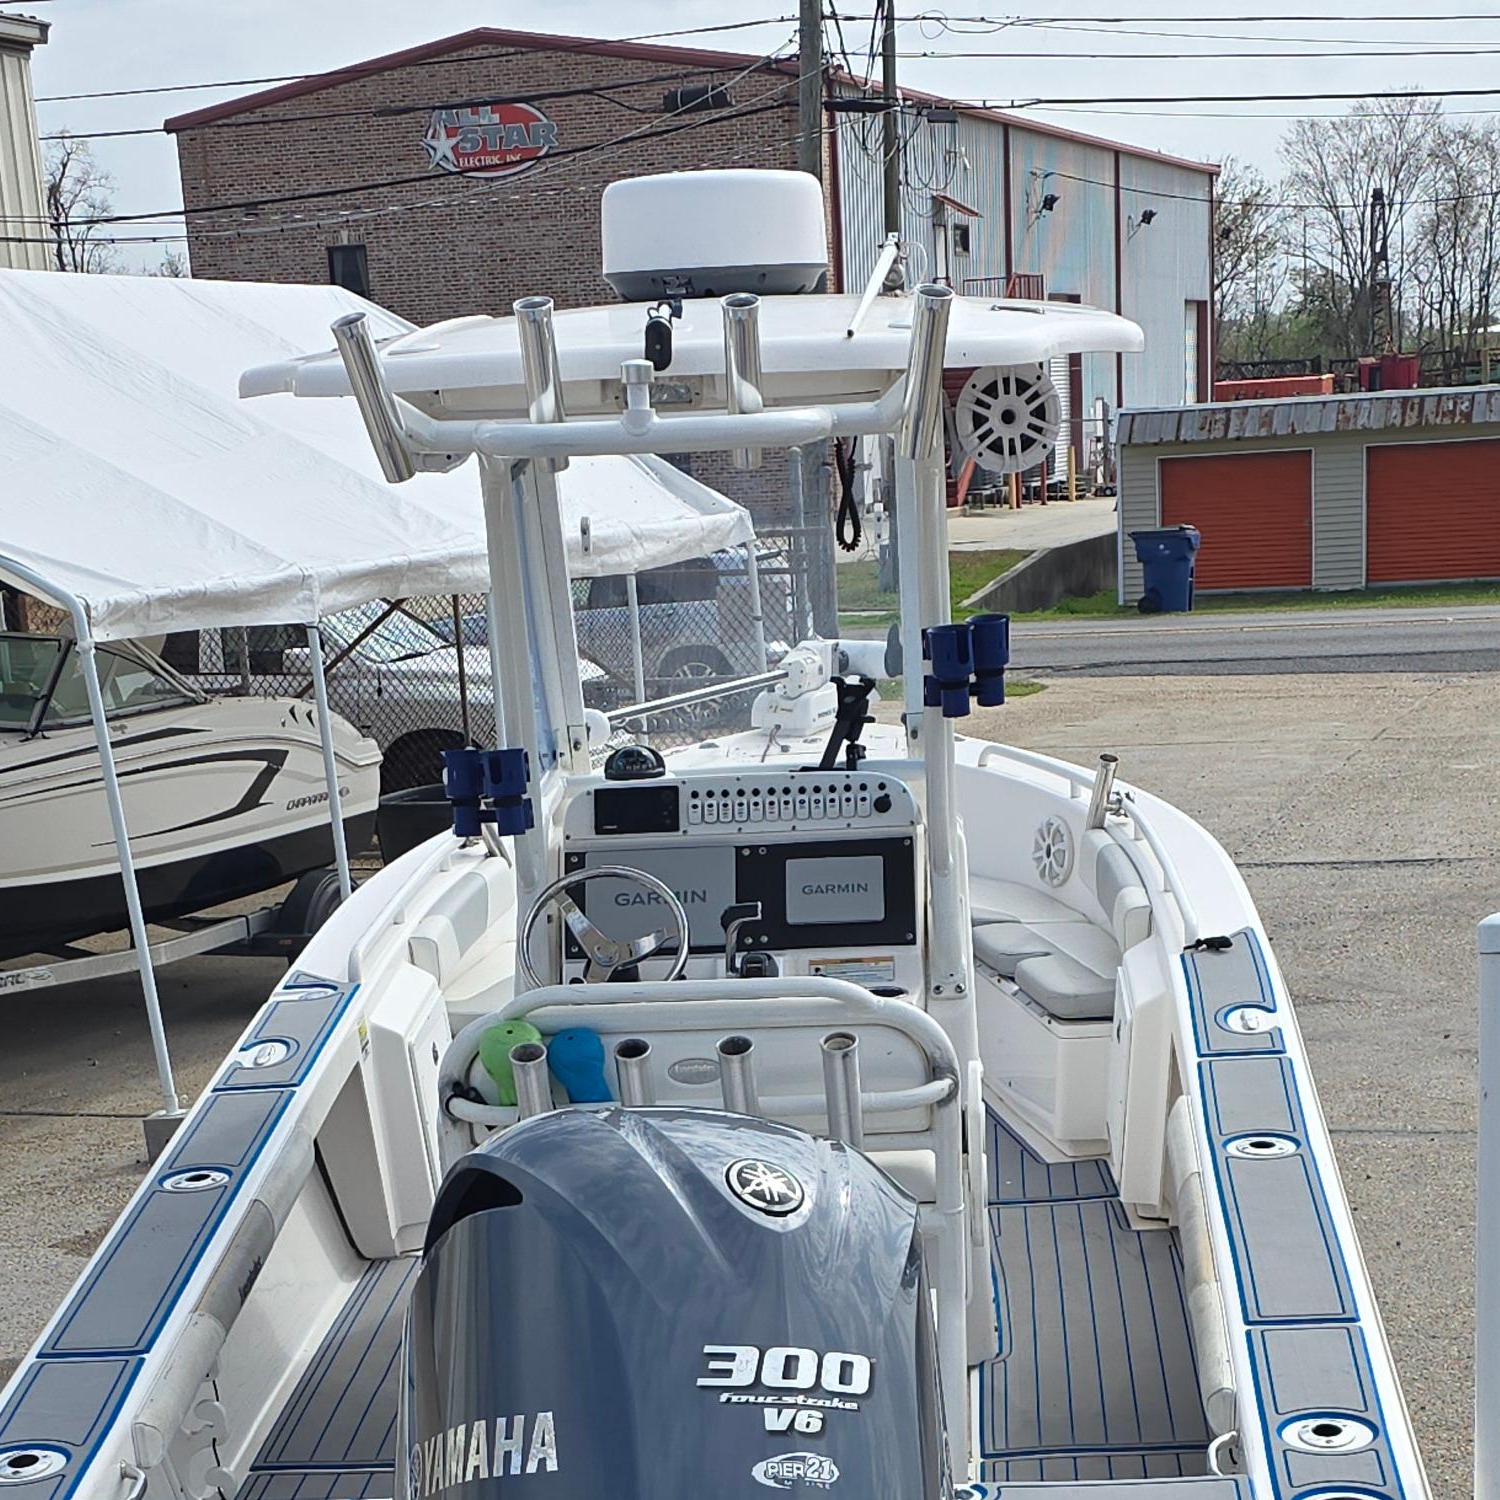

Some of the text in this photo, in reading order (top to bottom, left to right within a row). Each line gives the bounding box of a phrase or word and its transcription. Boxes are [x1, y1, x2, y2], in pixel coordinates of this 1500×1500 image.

[431, 107, 499, 126] ALL
[458, 122, 558, 152] STAR
[614, 889, 707, 906] GARIN
[802, 883, 868, 895] GARMIN
[696, 1345, 871, 1394] 300
[763, 1407, 823, 1433] V6
[424, 1411, 558, 1497] YAMAHA
[767, 1456, 833, 1480] PIER 21
